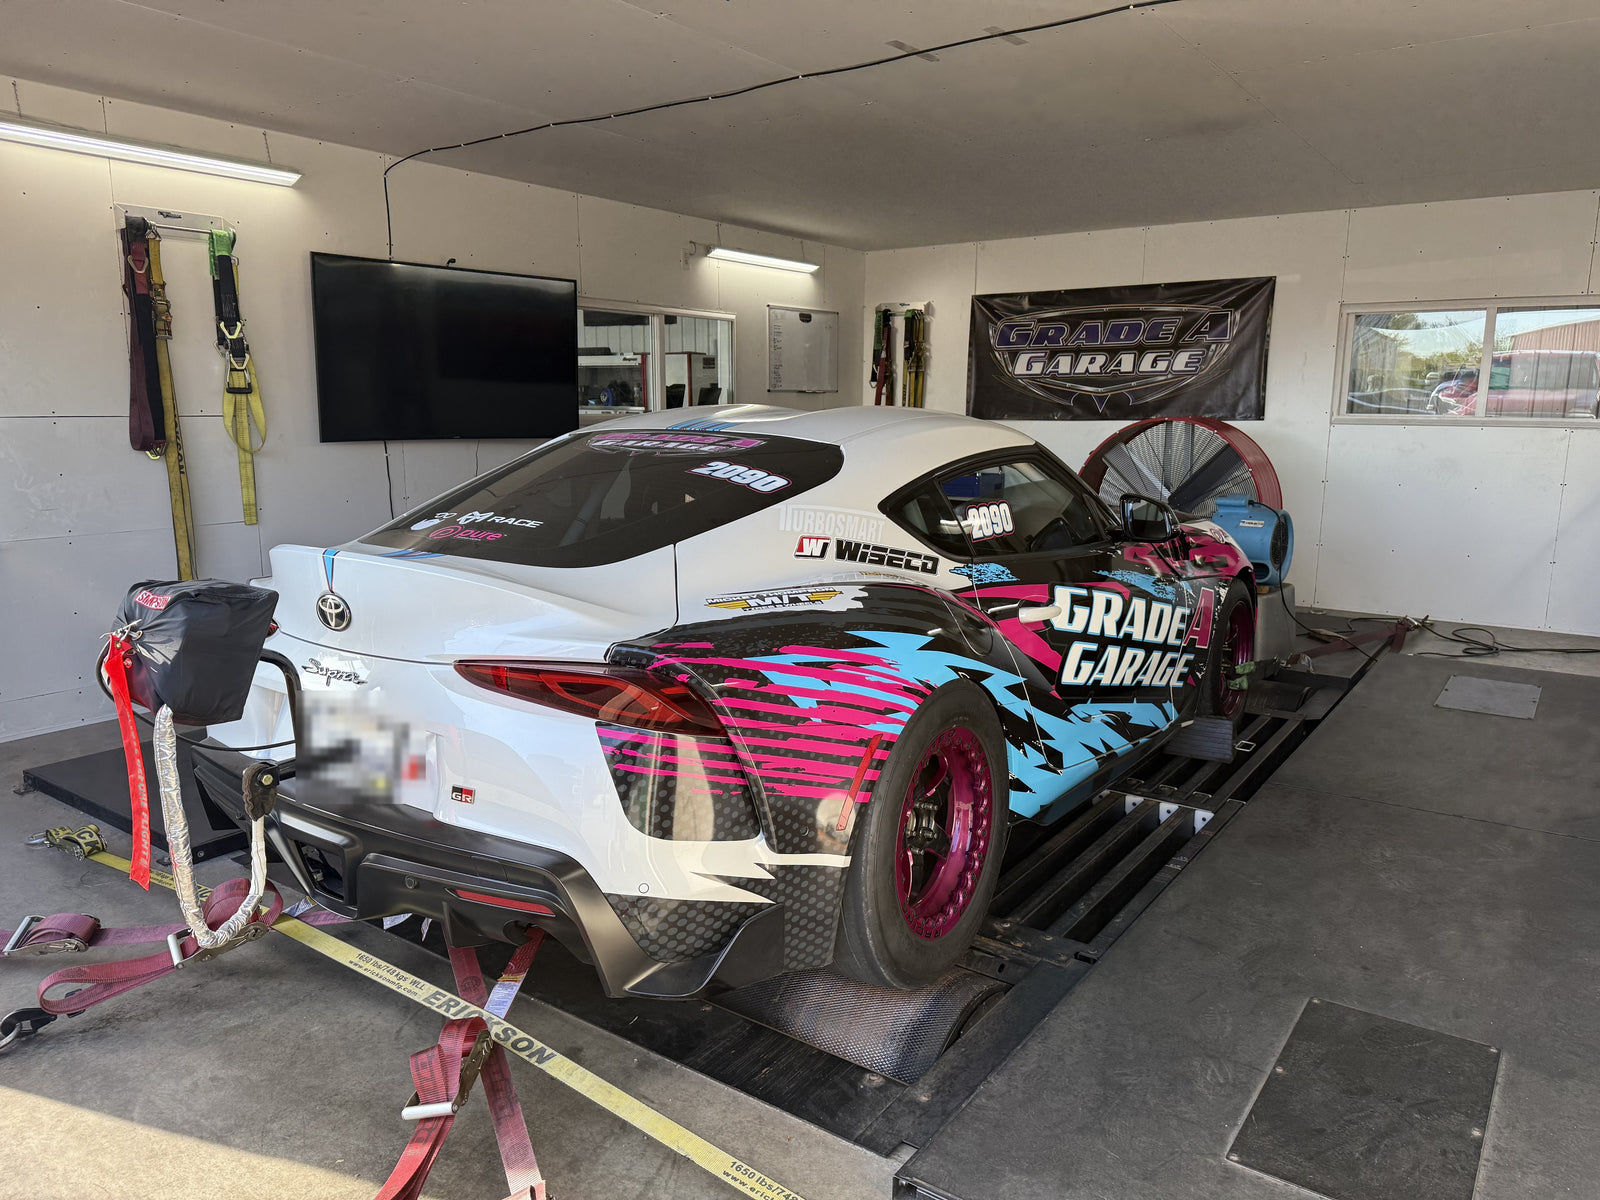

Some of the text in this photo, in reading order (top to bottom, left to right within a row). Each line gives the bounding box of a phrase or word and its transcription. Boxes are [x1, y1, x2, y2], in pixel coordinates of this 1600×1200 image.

[994, 309, 1234, 349] GRADE A
[1011, 349, 1206, 376] GARAGE
[688, 460, 791, 493] 2090
[454, 528, 502, 541] pure
[487, 516, 544, 528] RACE
[778, 503, 886, 542] TURBOSMART
[967, 500, 1015, 542] 2090
[707, 594, 757, 604] MICKEY
[1053, 585, 1214, 649] GRADE A
[301, 657, 368, 687] Supra
[1060, 641, 1196, 688] GARAGE
[452, 791, 473, 803] GR
[355, 953, 371, 964] 1650
[395, 970, 408, 983] kgs
[410, 979, 424, 990] WLL
[730, 1161, 756, 1180] 1650
